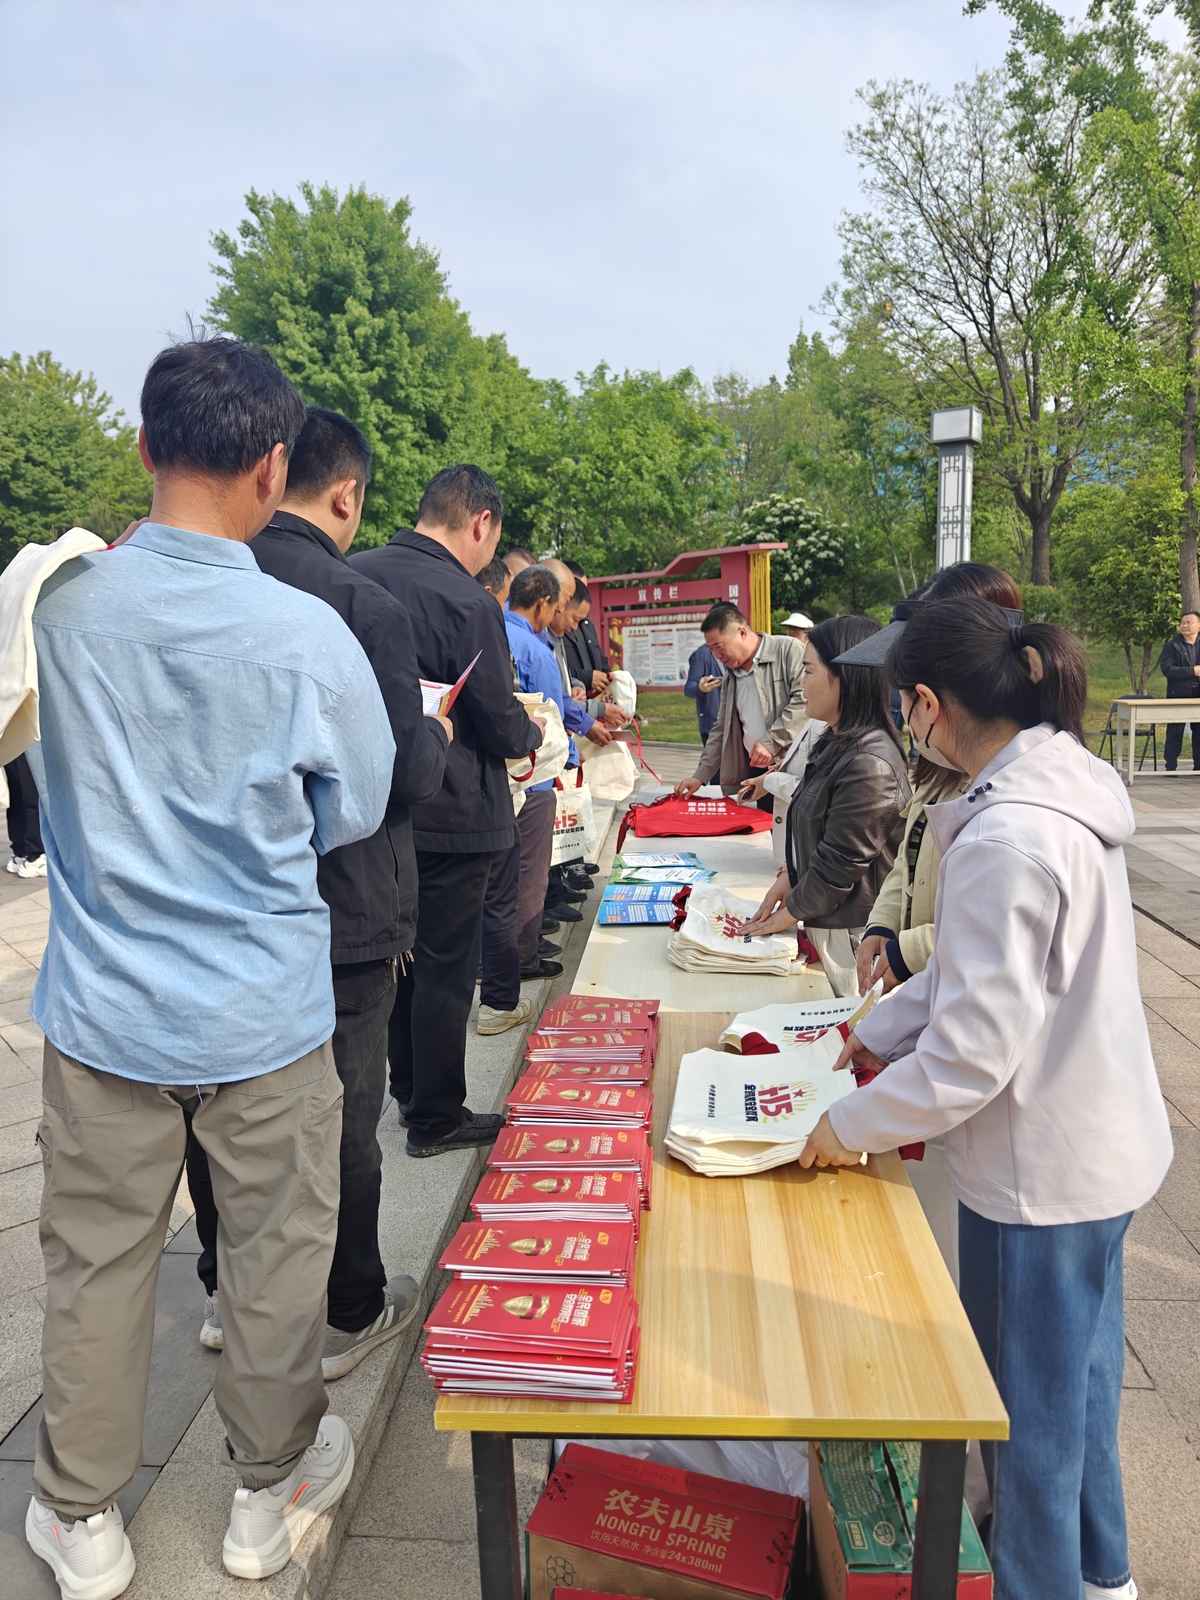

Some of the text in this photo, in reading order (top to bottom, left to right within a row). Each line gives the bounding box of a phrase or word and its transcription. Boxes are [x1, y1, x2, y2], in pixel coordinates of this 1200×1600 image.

[638, 586, 678, 602] 宣传栏
[758, 1085, 794, 1117] 415
[559, 1236, 576, 1258] 安全教育日
[573, 1238, 591, 1261] 全民国家
[556, 1293, 576, 1322] 安全教育日
[570, 1294, 592, 1326] 全民国家
[604, 1488, 735, 1542] 农夫山泉
[590, 1529, 640, 1551] 饮用天然水
[595, 1513, 728, 1560] NONGFU SPRING
